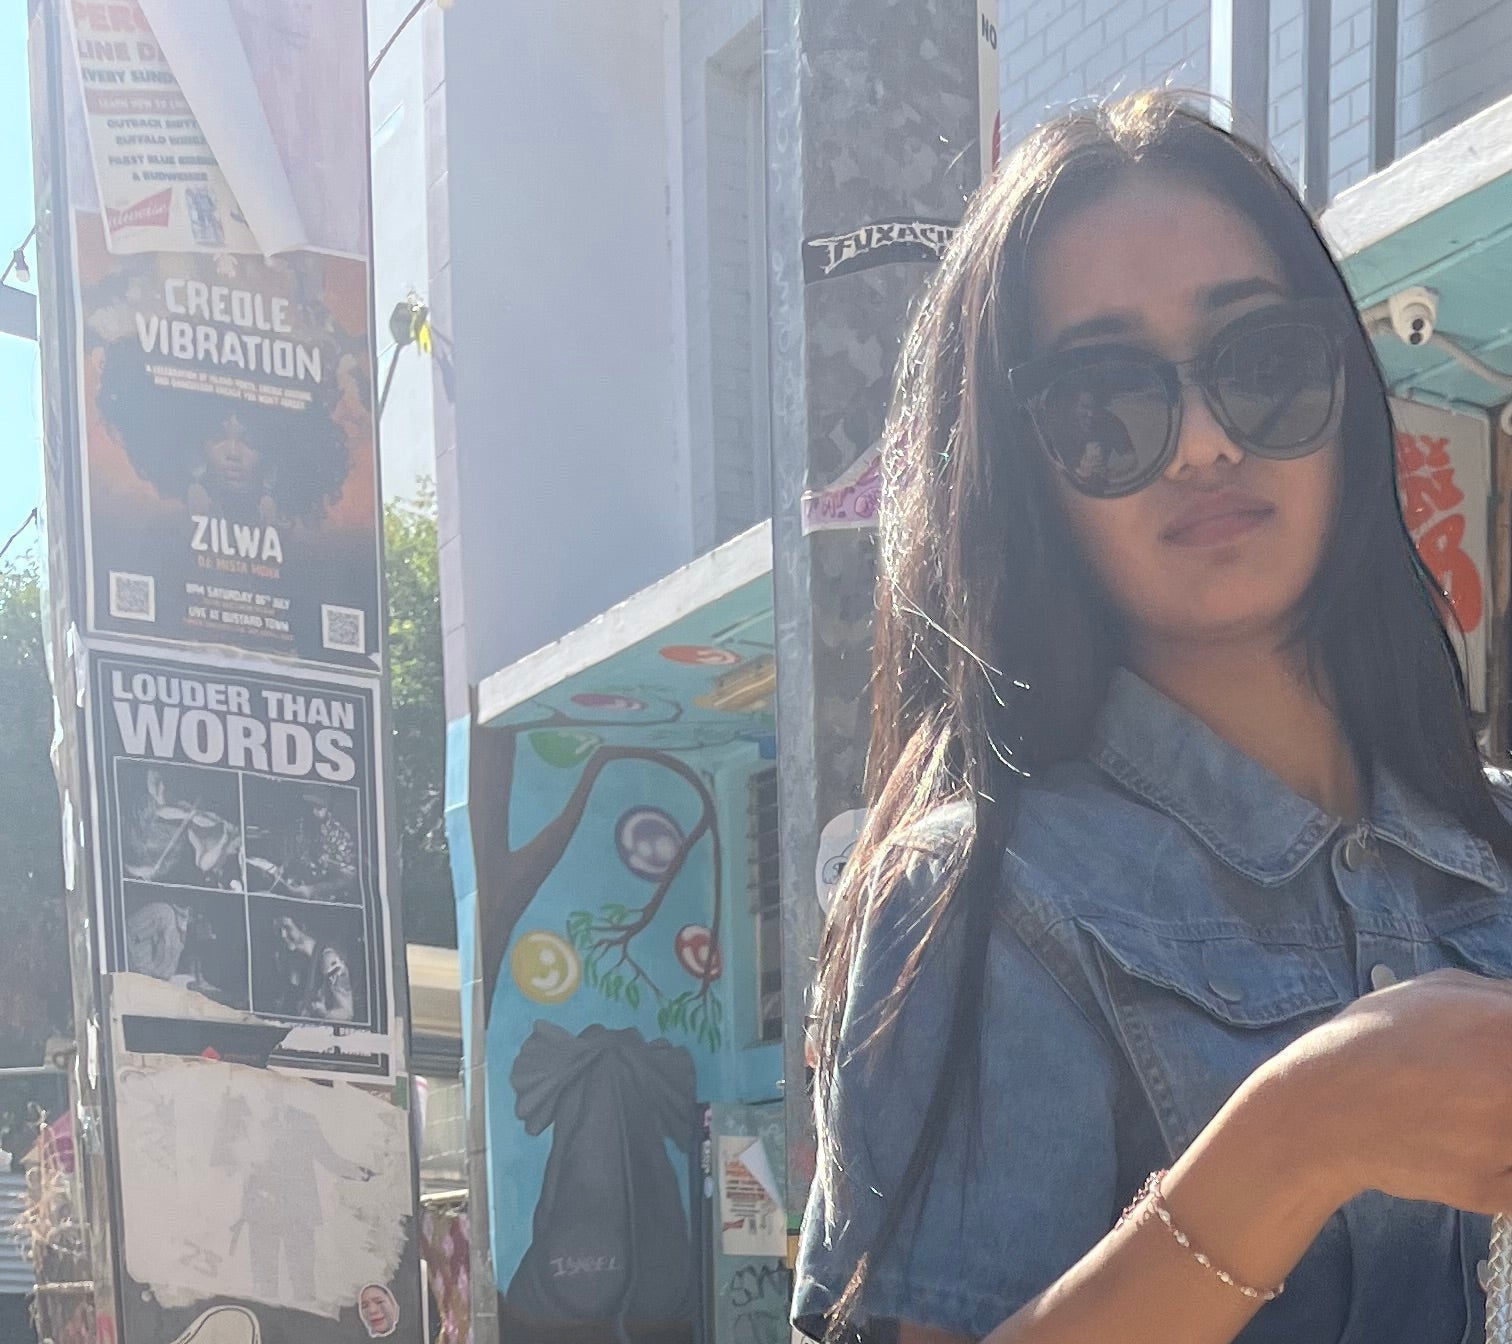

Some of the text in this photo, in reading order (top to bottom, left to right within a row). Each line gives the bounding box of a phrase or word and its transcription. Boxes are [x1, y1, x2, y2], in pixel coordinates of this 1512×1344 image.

[164, 277, 293, 333] CREOLE
[135, 311, 322, 384] VIBRATION
[190, 515, 283, 564] ZILWA
[111, 670, 355, 730] LOUDER THAN
[112, 700, 357, 782] WORDS
